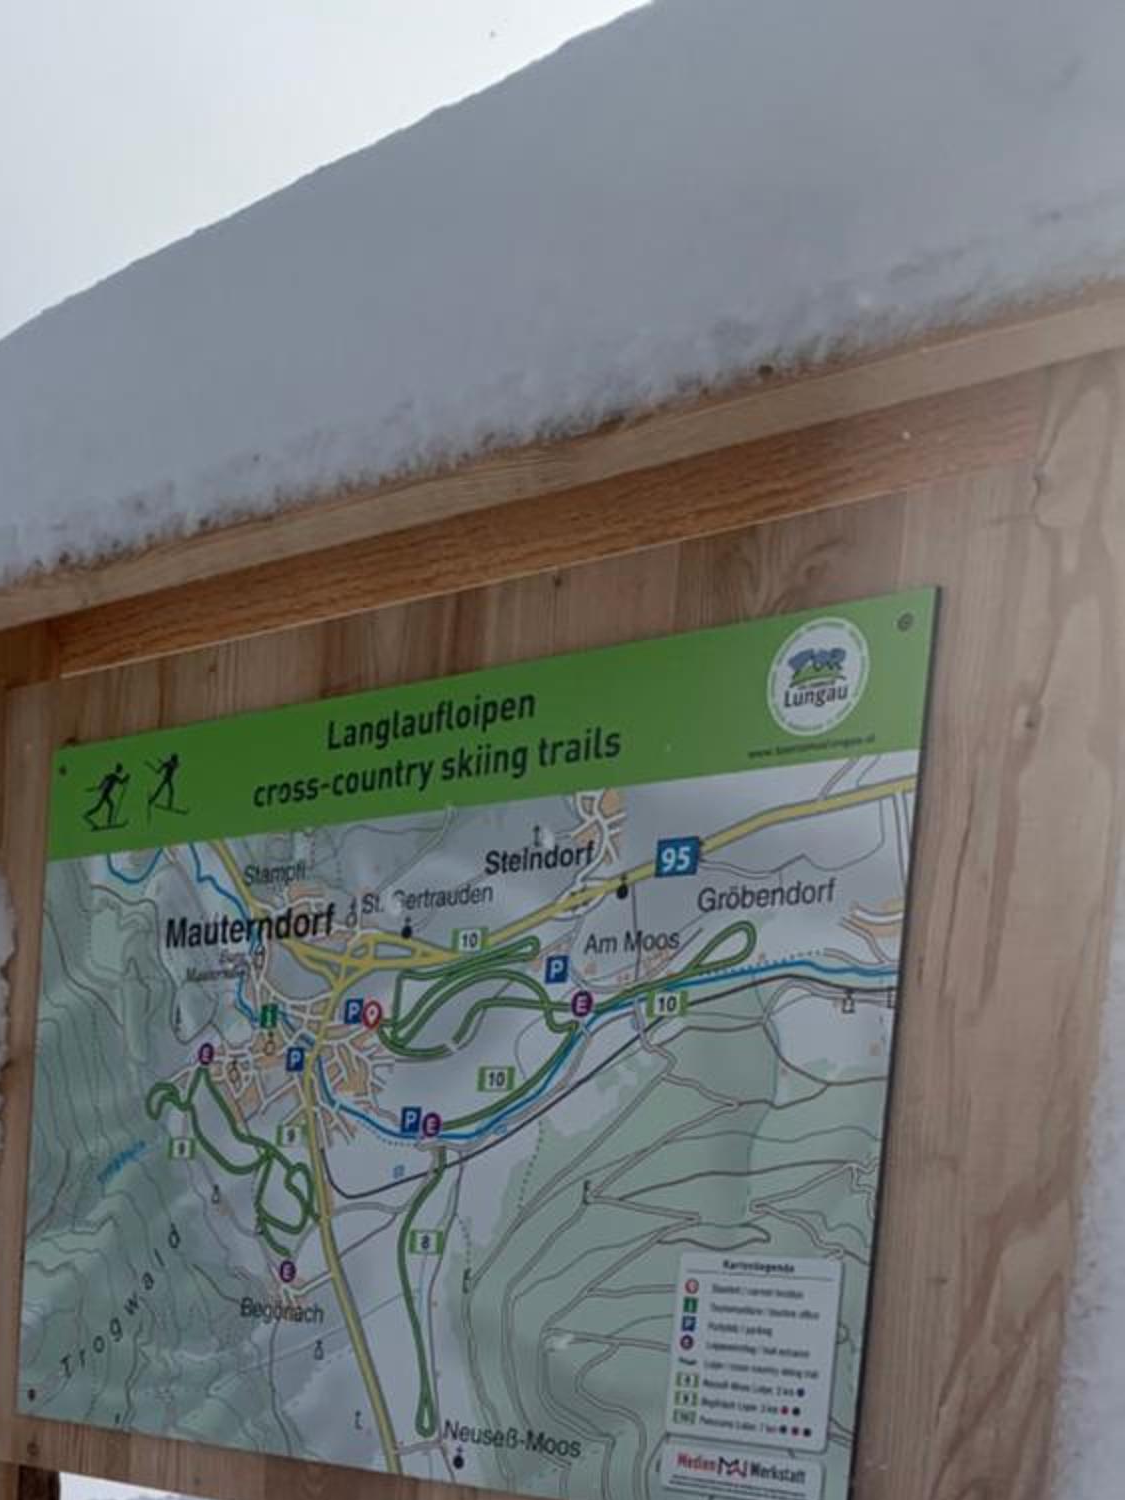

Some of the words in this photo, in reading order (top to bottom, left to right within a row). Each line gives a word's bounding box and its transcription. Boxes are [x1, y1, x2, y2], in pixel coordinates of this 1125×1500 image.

[784, 685, 849, 708] Lungau
[328, 693, 536, 750] Langlaufloipen
[253, 756, 434, 807] cross-country
[442, 744, 528, 781] skiing
[539, 726, 621, 767] trails
[485, 840, 594, 875] Steindorf
[661, 847, 691, 872] 95
[362, 893, 385, 914] St.
[697, 877, 836, 912] Gröbendorf
[166, 902, 334, 948] Mauterndorf
[462, 933, 479, 949] 10
[584, 934, 617, 954] Am
[624, 931, 681, 951] Moos
[658, 995, 677, 1013] 10
[488, 1071, 505, 1087] 10
